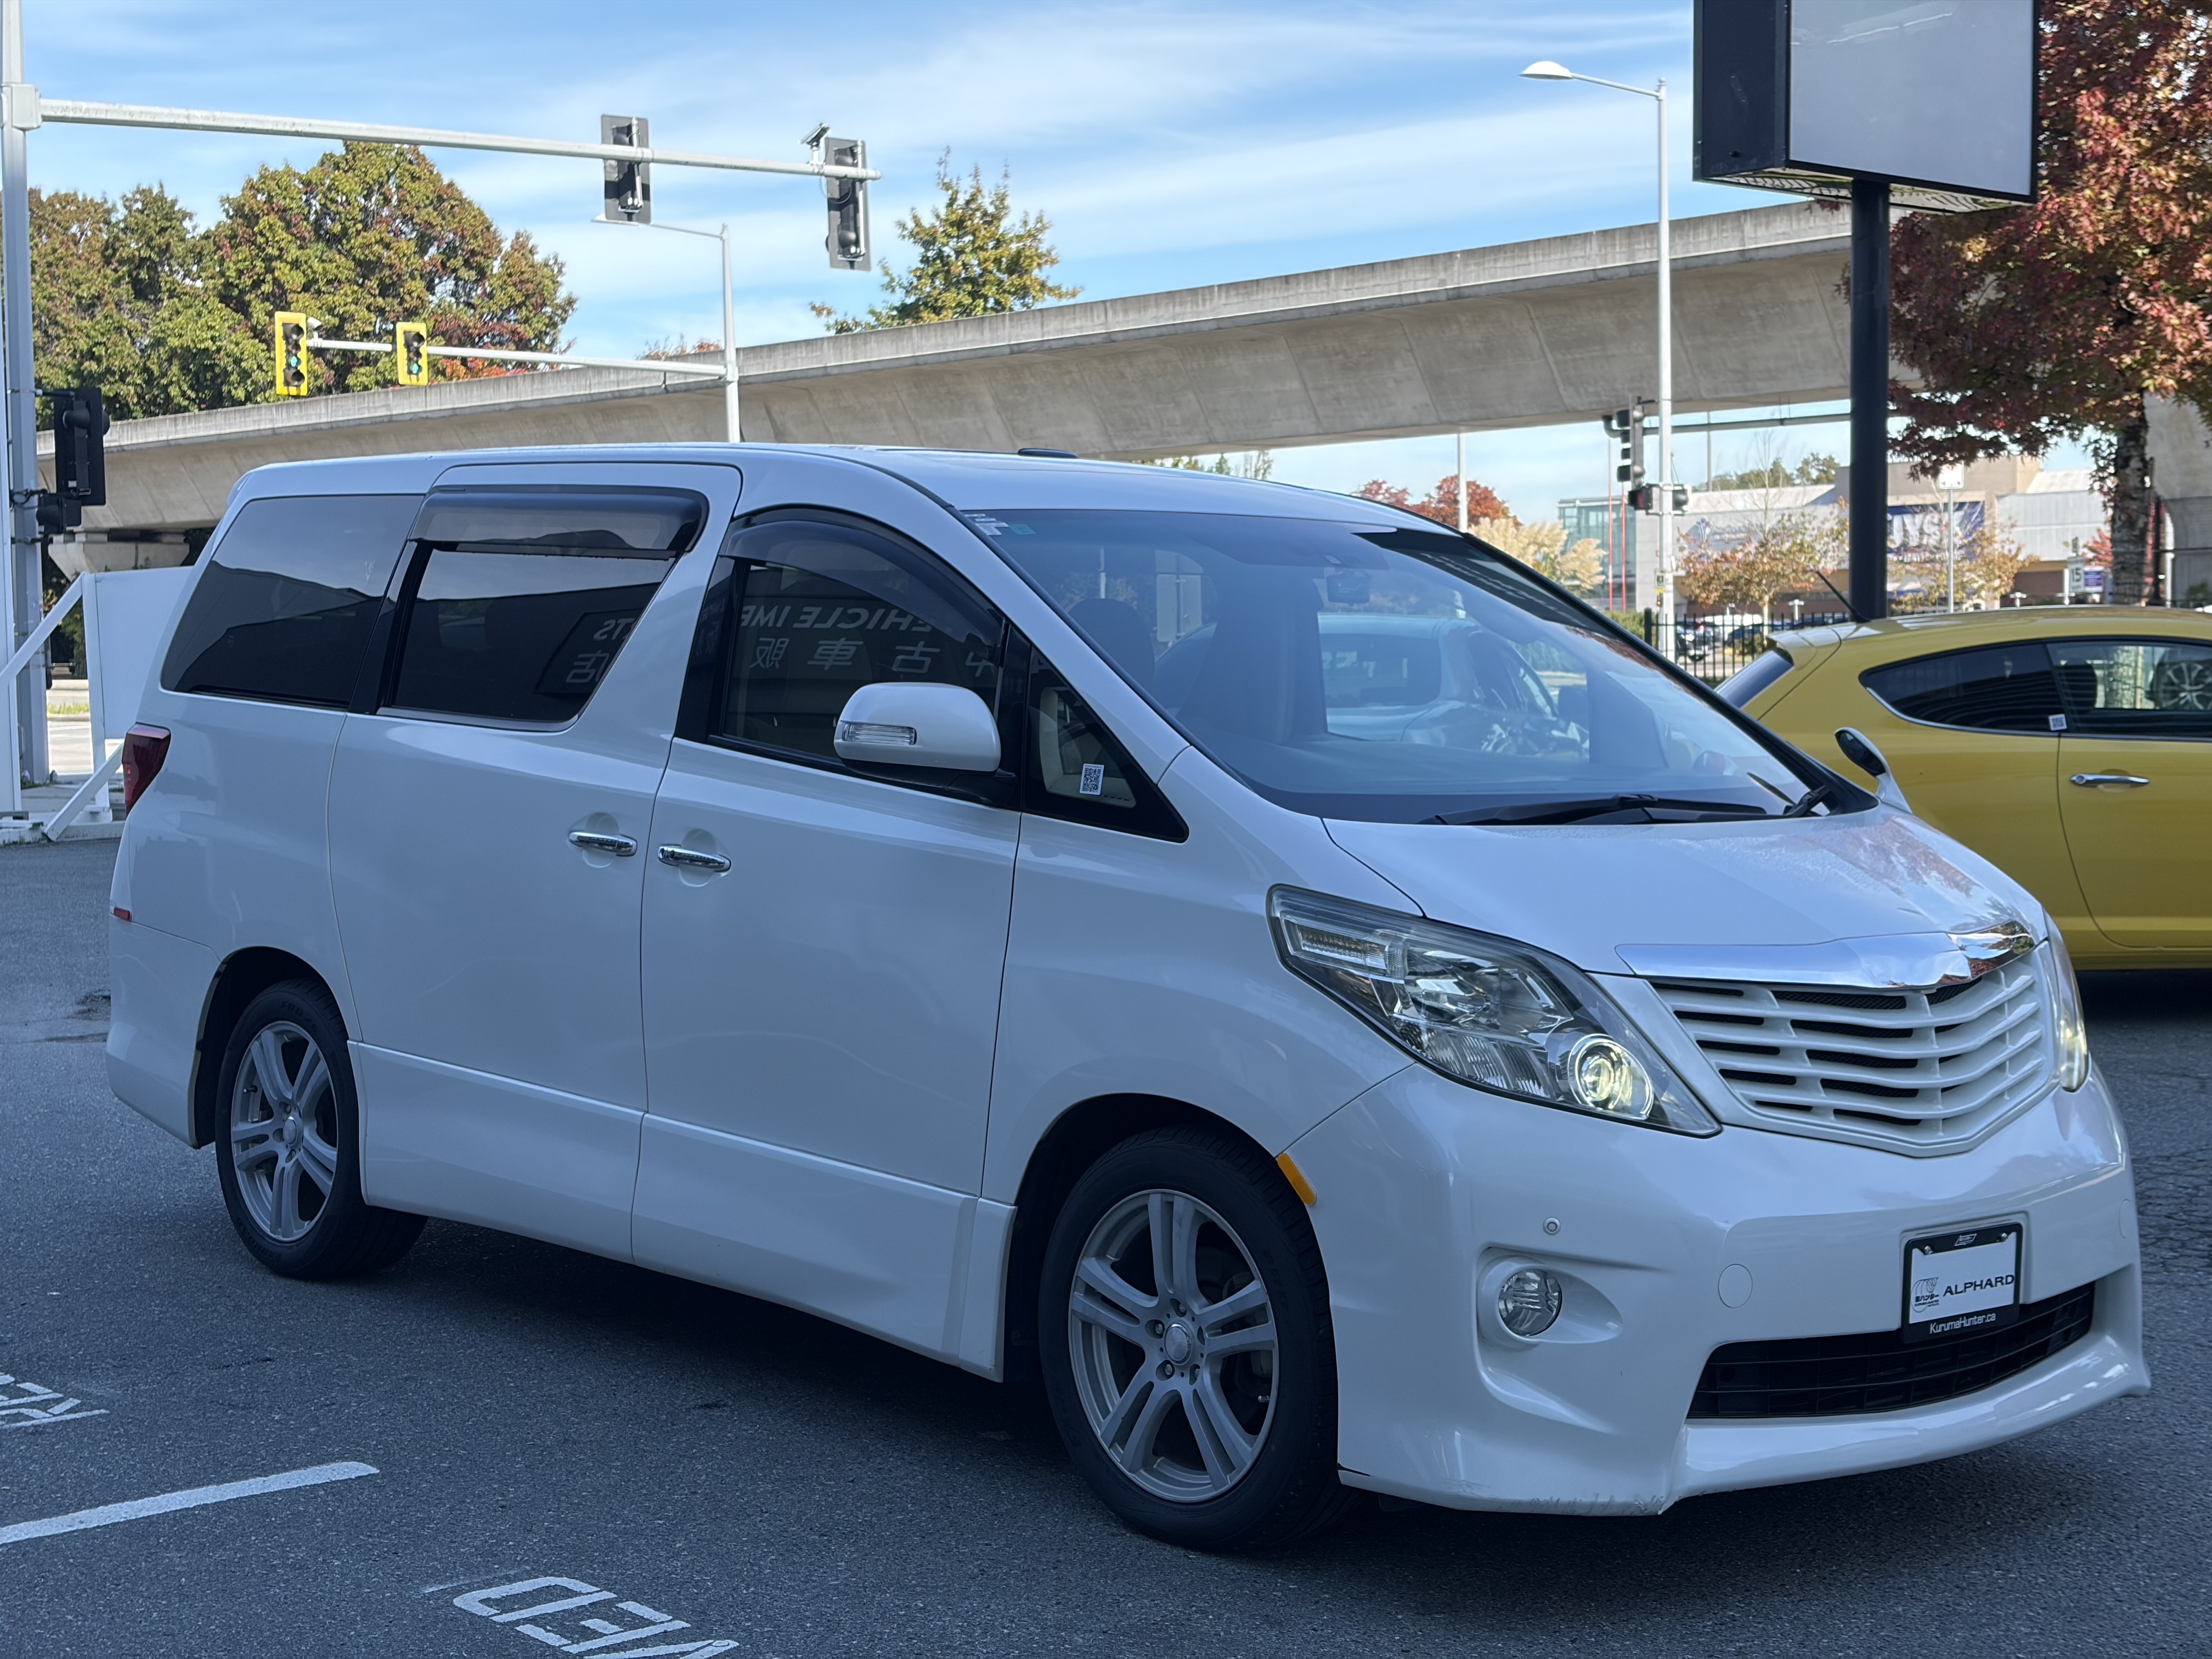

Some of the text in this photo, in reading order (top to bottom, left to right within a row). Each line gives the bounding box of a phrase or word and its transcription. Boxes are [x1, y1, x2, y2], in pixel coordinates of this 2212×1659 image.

[2071, 567, 2082, 582] 15
[1943, 1274, 2015, 1296] ALPHARD
[1929, 1313, 1996, 1334] KurumaHunter.ca
